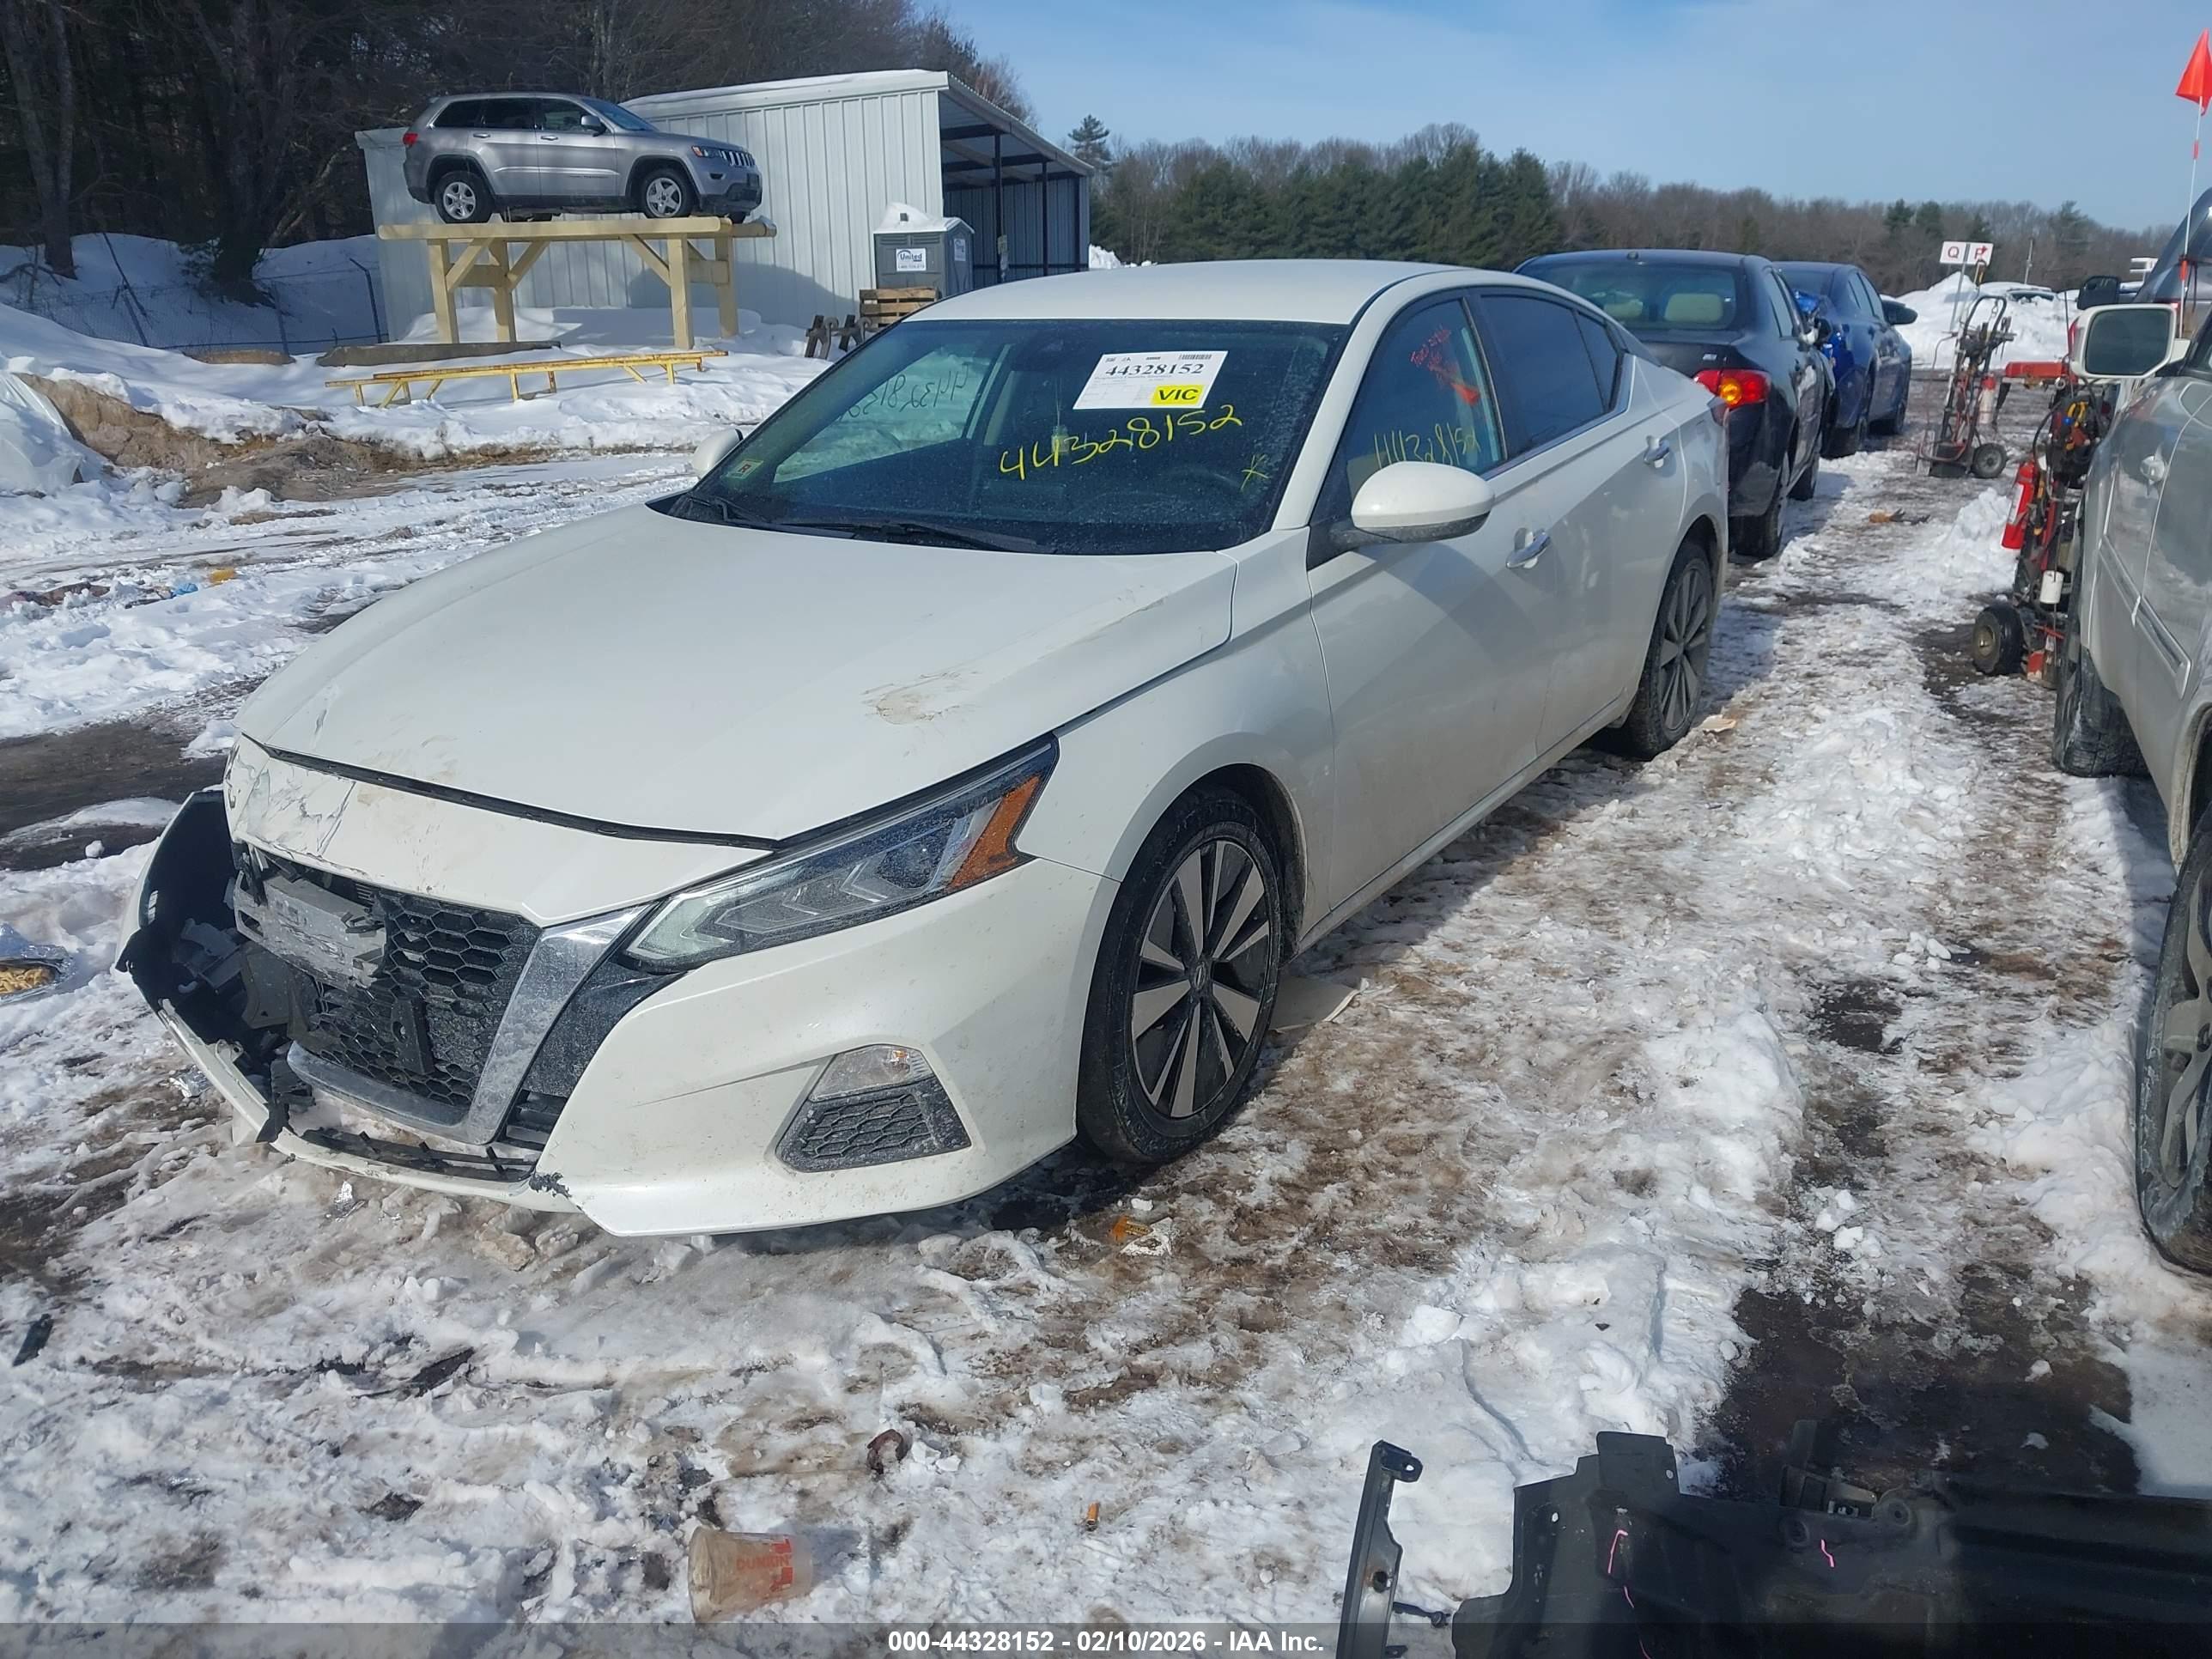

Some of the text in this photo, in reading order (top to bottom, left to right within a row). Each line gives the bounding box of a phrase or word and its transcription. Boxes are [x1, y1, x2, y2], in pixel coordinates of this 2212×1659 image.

[900, 252, 922, 261] United
[1948, 246, 1960, 258] Q
[1105, 363, 1205, 376] 44328152
[1158, 388, 1199, 401] VIC
[999, 404, 1243, 480] 44328152
